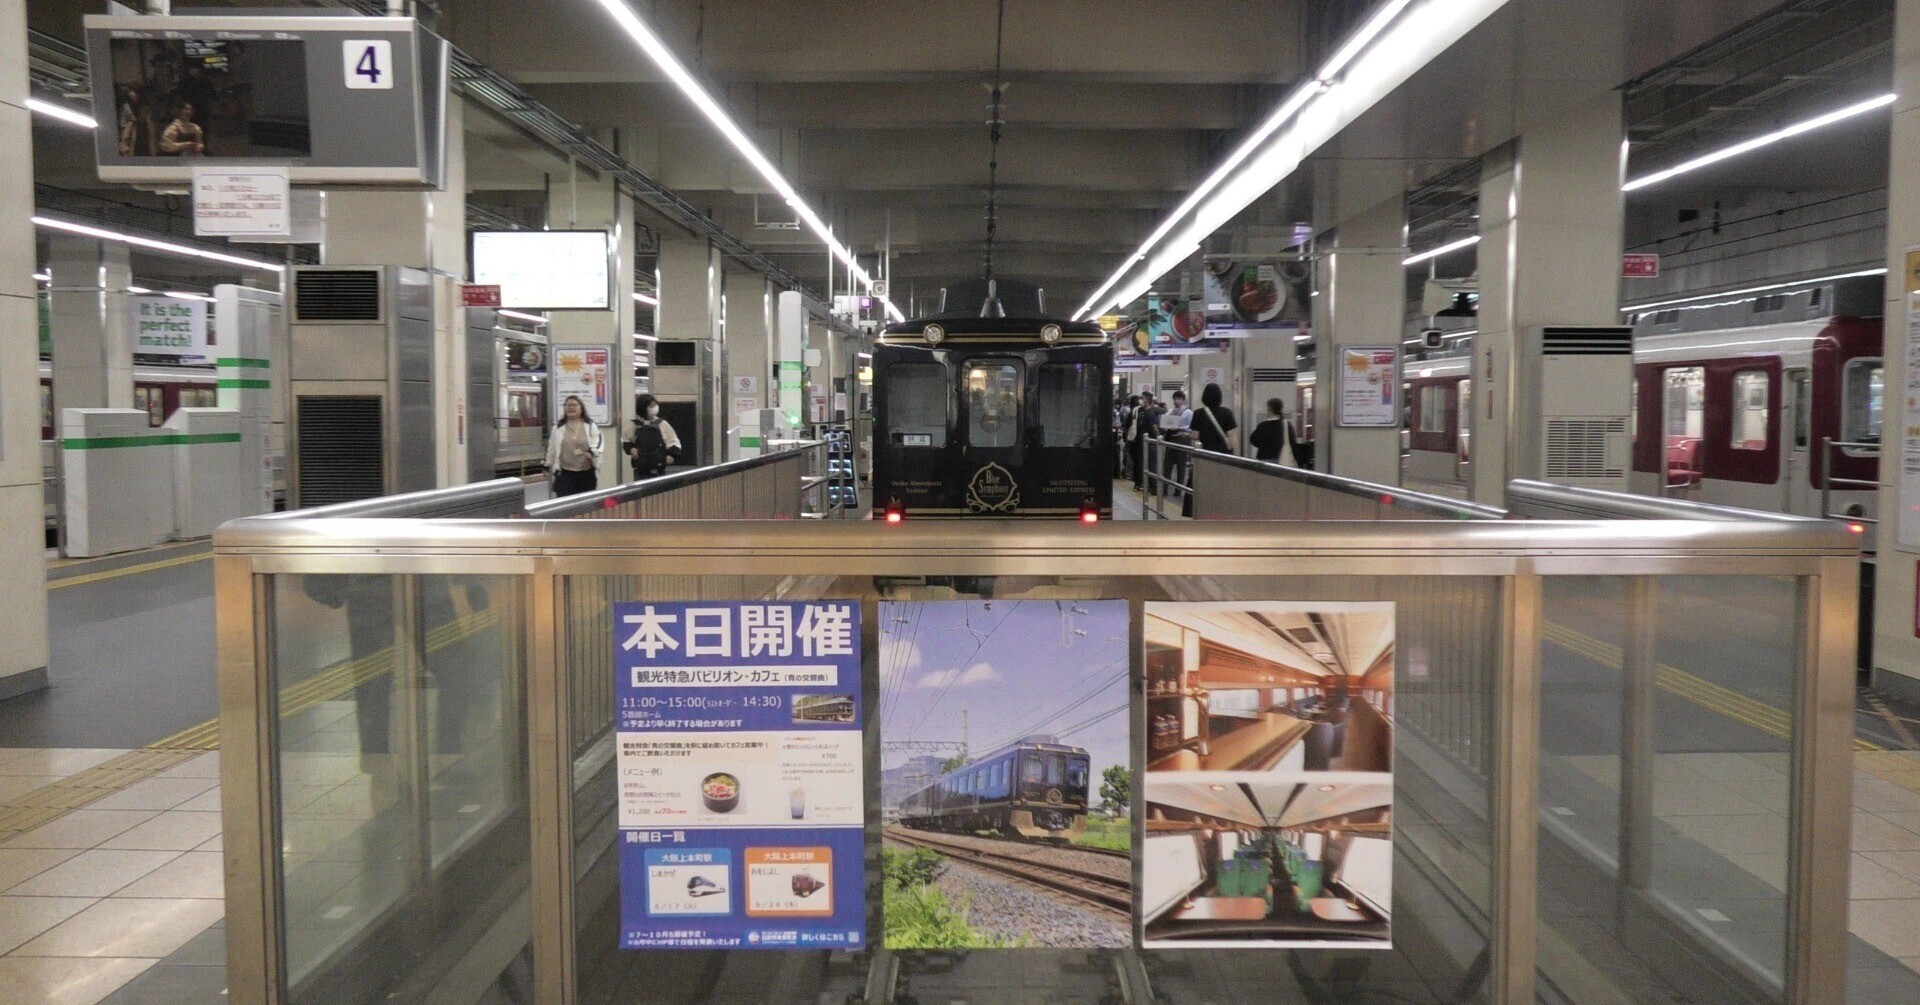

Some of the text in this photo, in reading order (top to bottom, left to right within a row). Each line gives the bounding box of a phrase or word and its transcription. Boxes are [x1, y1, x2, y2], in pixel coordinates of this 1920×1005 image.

[355, 46, 382, 83] 4
[155, 303, 166, 316] is
[170, 303, 192, 316] the
[140, 318, 192, 334] perfect
[140, 334, 192, 347] match!
[985, 470, 1000, 484] Blue
[978, 480, 1009, 494] Symphony
[621, 604, 854, 659] 本日開催
[626, 831, 686, 843] 開催日一覧
[662, 853, 712, 862] 大阪上本町駅
[764, 851, 815, 861] 大阪上本町駅
